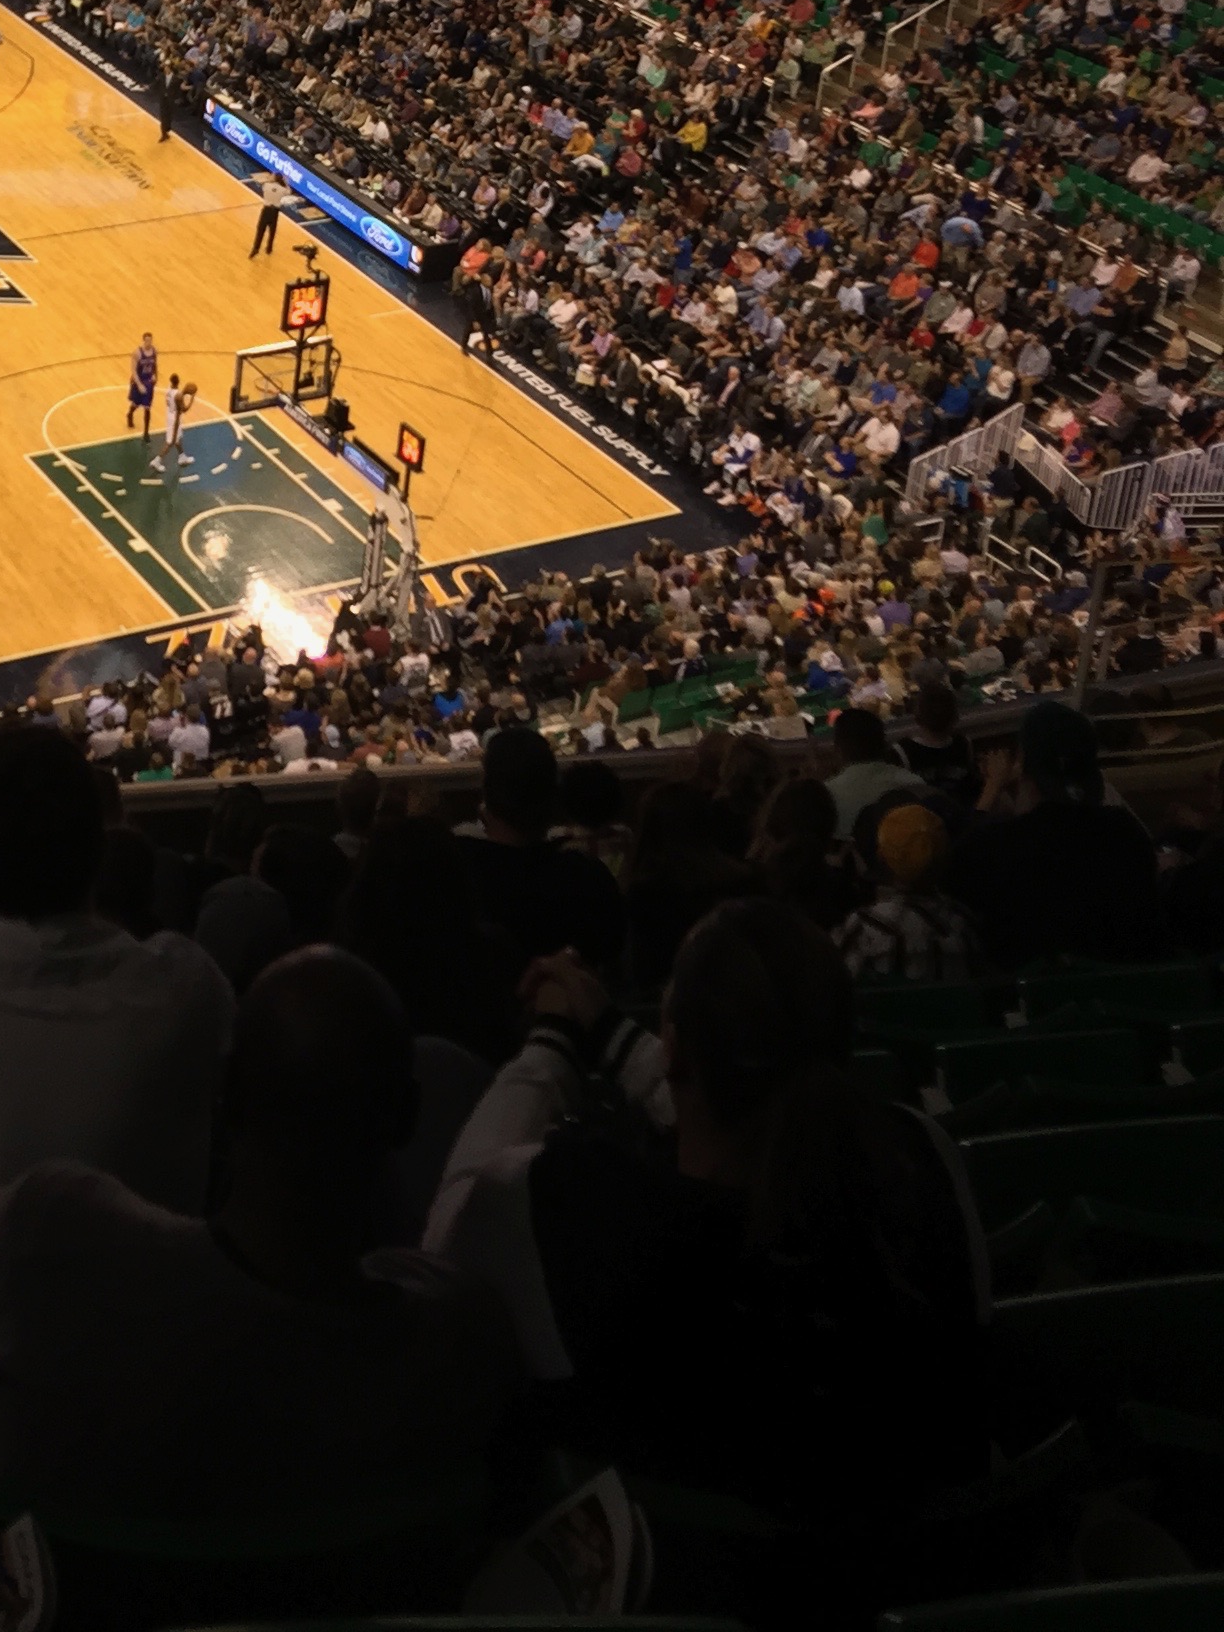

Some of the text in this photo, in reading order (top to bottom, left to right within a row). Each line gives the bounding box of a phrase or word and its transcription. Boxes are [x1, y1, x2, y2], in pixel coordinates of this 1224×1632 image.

[255, 141, 304, 184] Go Further
[290, 298, 322, 327] 24
[491, 349, 672, 477] UNITED FUEL SUPPLY
